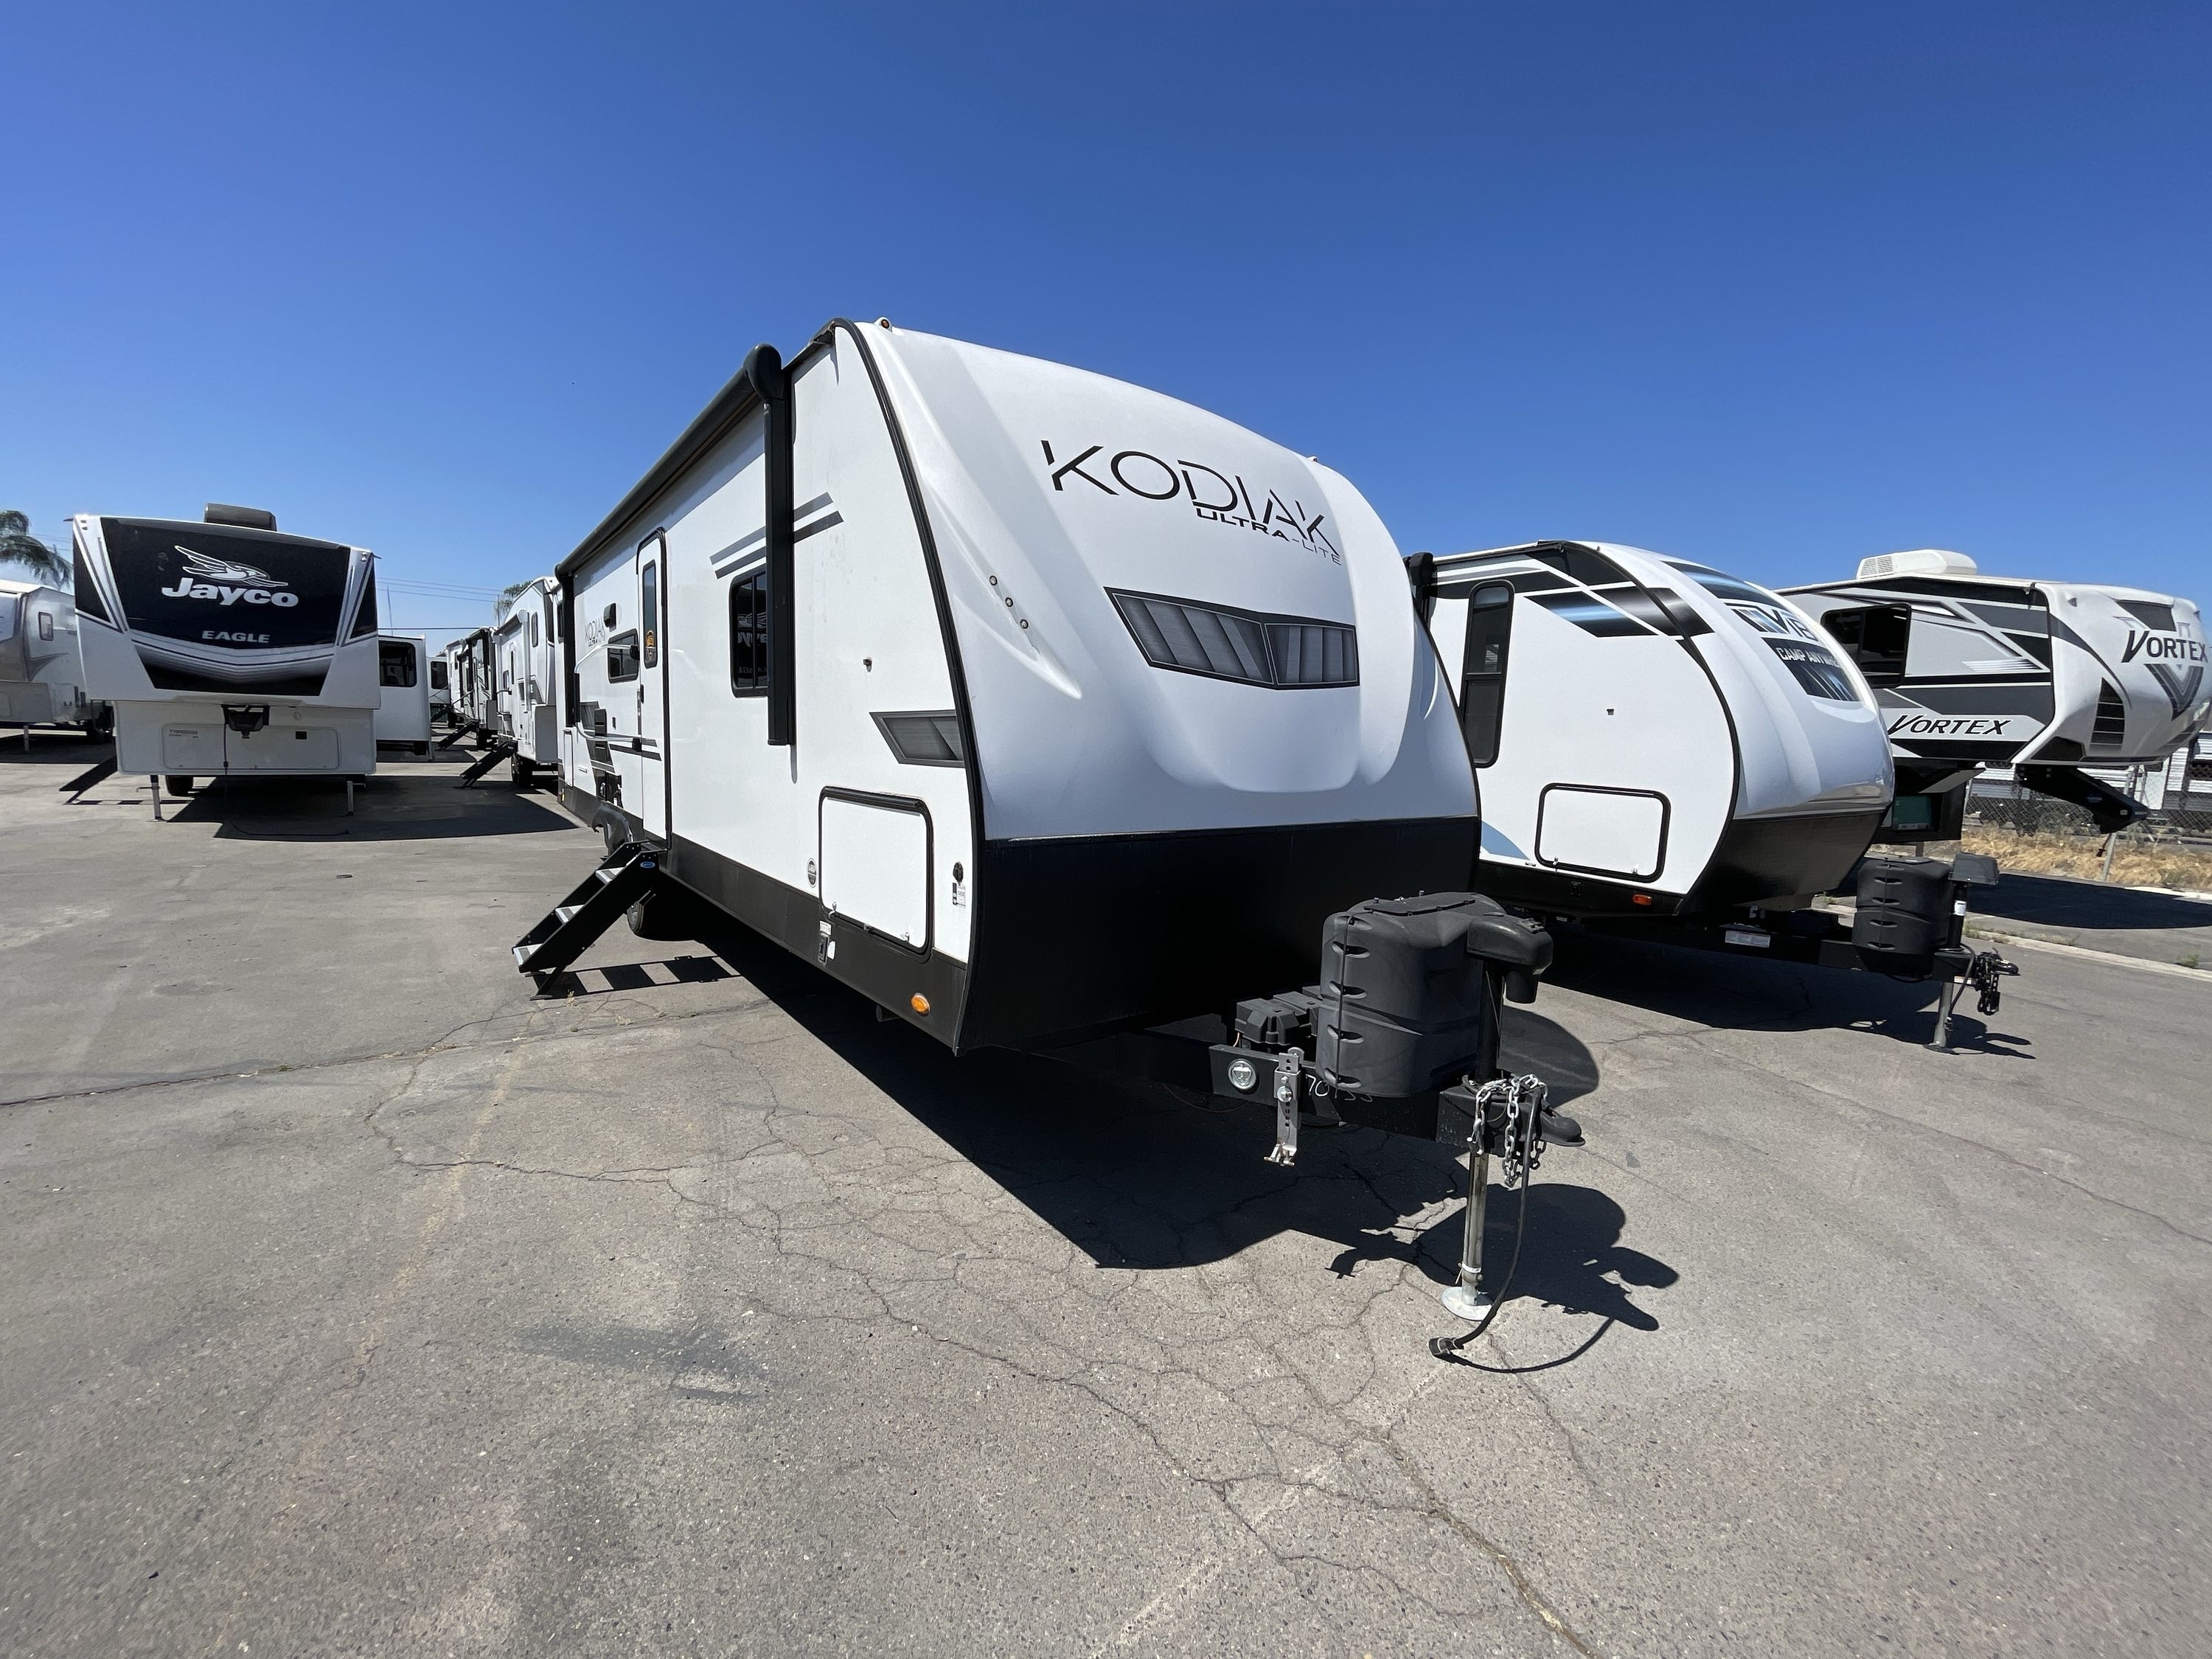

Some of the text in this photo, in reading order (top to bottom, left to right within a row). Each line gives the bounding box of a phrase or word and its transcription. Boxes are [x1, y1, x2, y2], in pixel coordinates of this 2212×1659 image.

[1040, 439, 1340, 557] KODIAK
[1195, 507, 1342, 566] ULTRA-LITE
[161, 577, 299, 608] Jayco
[201, 630, 270, 644] EAGLE
[1723, 602, 1819, 642] VIB
[1775, 647, 1806, 661] CAMP
[2121, 630, 2208, 663] VORTEX
[1887, 714, 2011, 735] VORTEX
